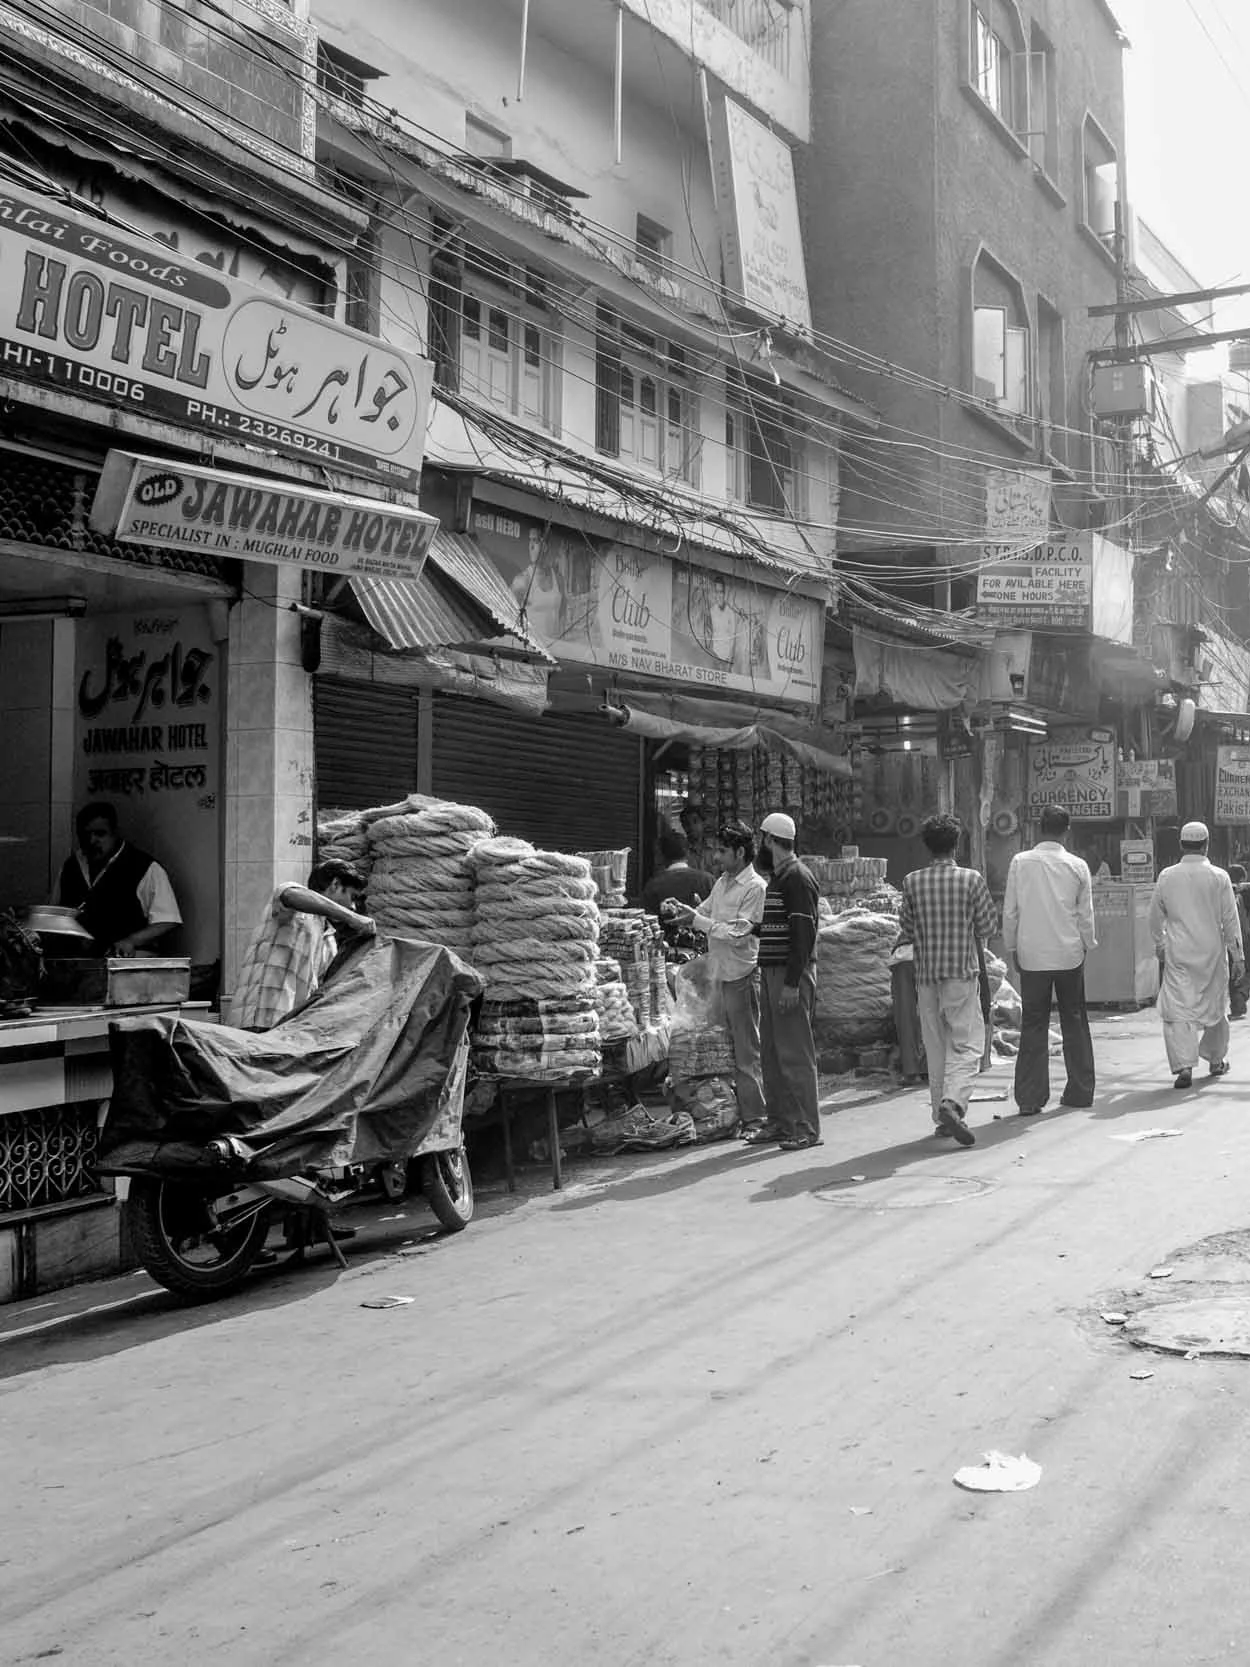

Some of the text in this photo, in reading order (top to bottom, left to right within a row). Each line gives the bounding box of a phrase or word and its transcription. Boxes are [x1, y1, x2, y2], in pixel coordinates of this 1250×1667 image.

[80, 235, 188, 287] Foods
[16, 250, 210, 389] HOTEL
[0, 341, 145, 401] HI-110006
[239, 416, 341, 460] 23269241
[141, 478, 178, 502] OLD
[130, 519, 212, 545] SPECIALIST
[216, 534, 232, 549] IN
[243, 540, 302, 560] MUGHLAI
[304, 549, 340, 566] FOOD
[342, 510, 428, 561] HOTEL
[982, 579, 1087, 589] FOR AVILABLE HERE
[1035, 567, 1082, 577] FACILITY
[611, 587, 650, 629] Club
[997, 591, 1054, 601] ONE HOURS
[777, 627, 806, 663] Club
[631, 656, 652, 671] NAV
[655, 661, 693, 677] BHARAT
[695, 669, 729, 683] STORE
[84, 723, 208, 754] JAWAHAR HOTEL
[150, 760, 207, 792] होटल
[1031, 788, 1108, 805] CURRENCY
